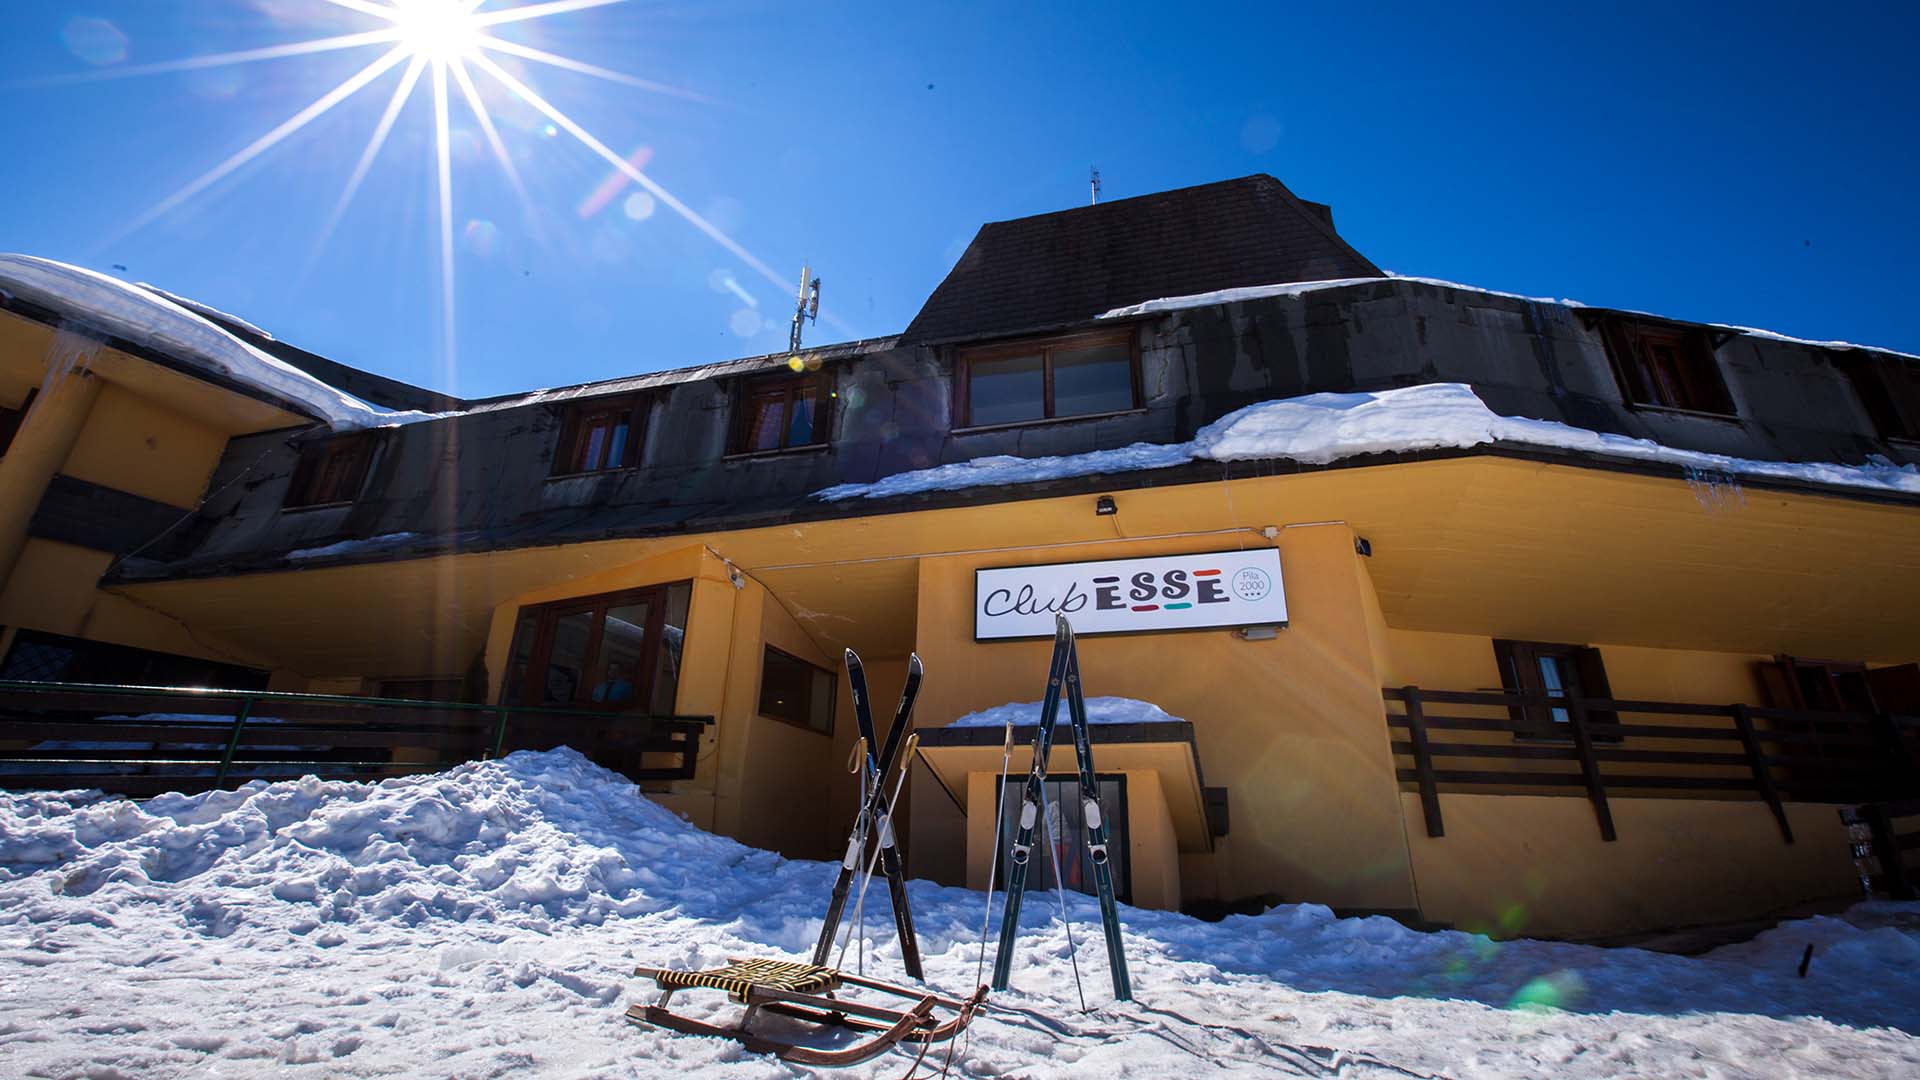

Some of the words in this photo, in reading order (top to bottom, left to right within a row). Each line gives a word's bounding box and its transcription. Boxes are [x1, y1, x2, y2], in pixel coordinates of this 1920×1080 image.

[1242, 571, 1260, 580] Pila
[1239, 580, 1265, 591] 2000
[983, 581, 1088, 617] Club
[1093, 569, 1230, 612] ESSE
